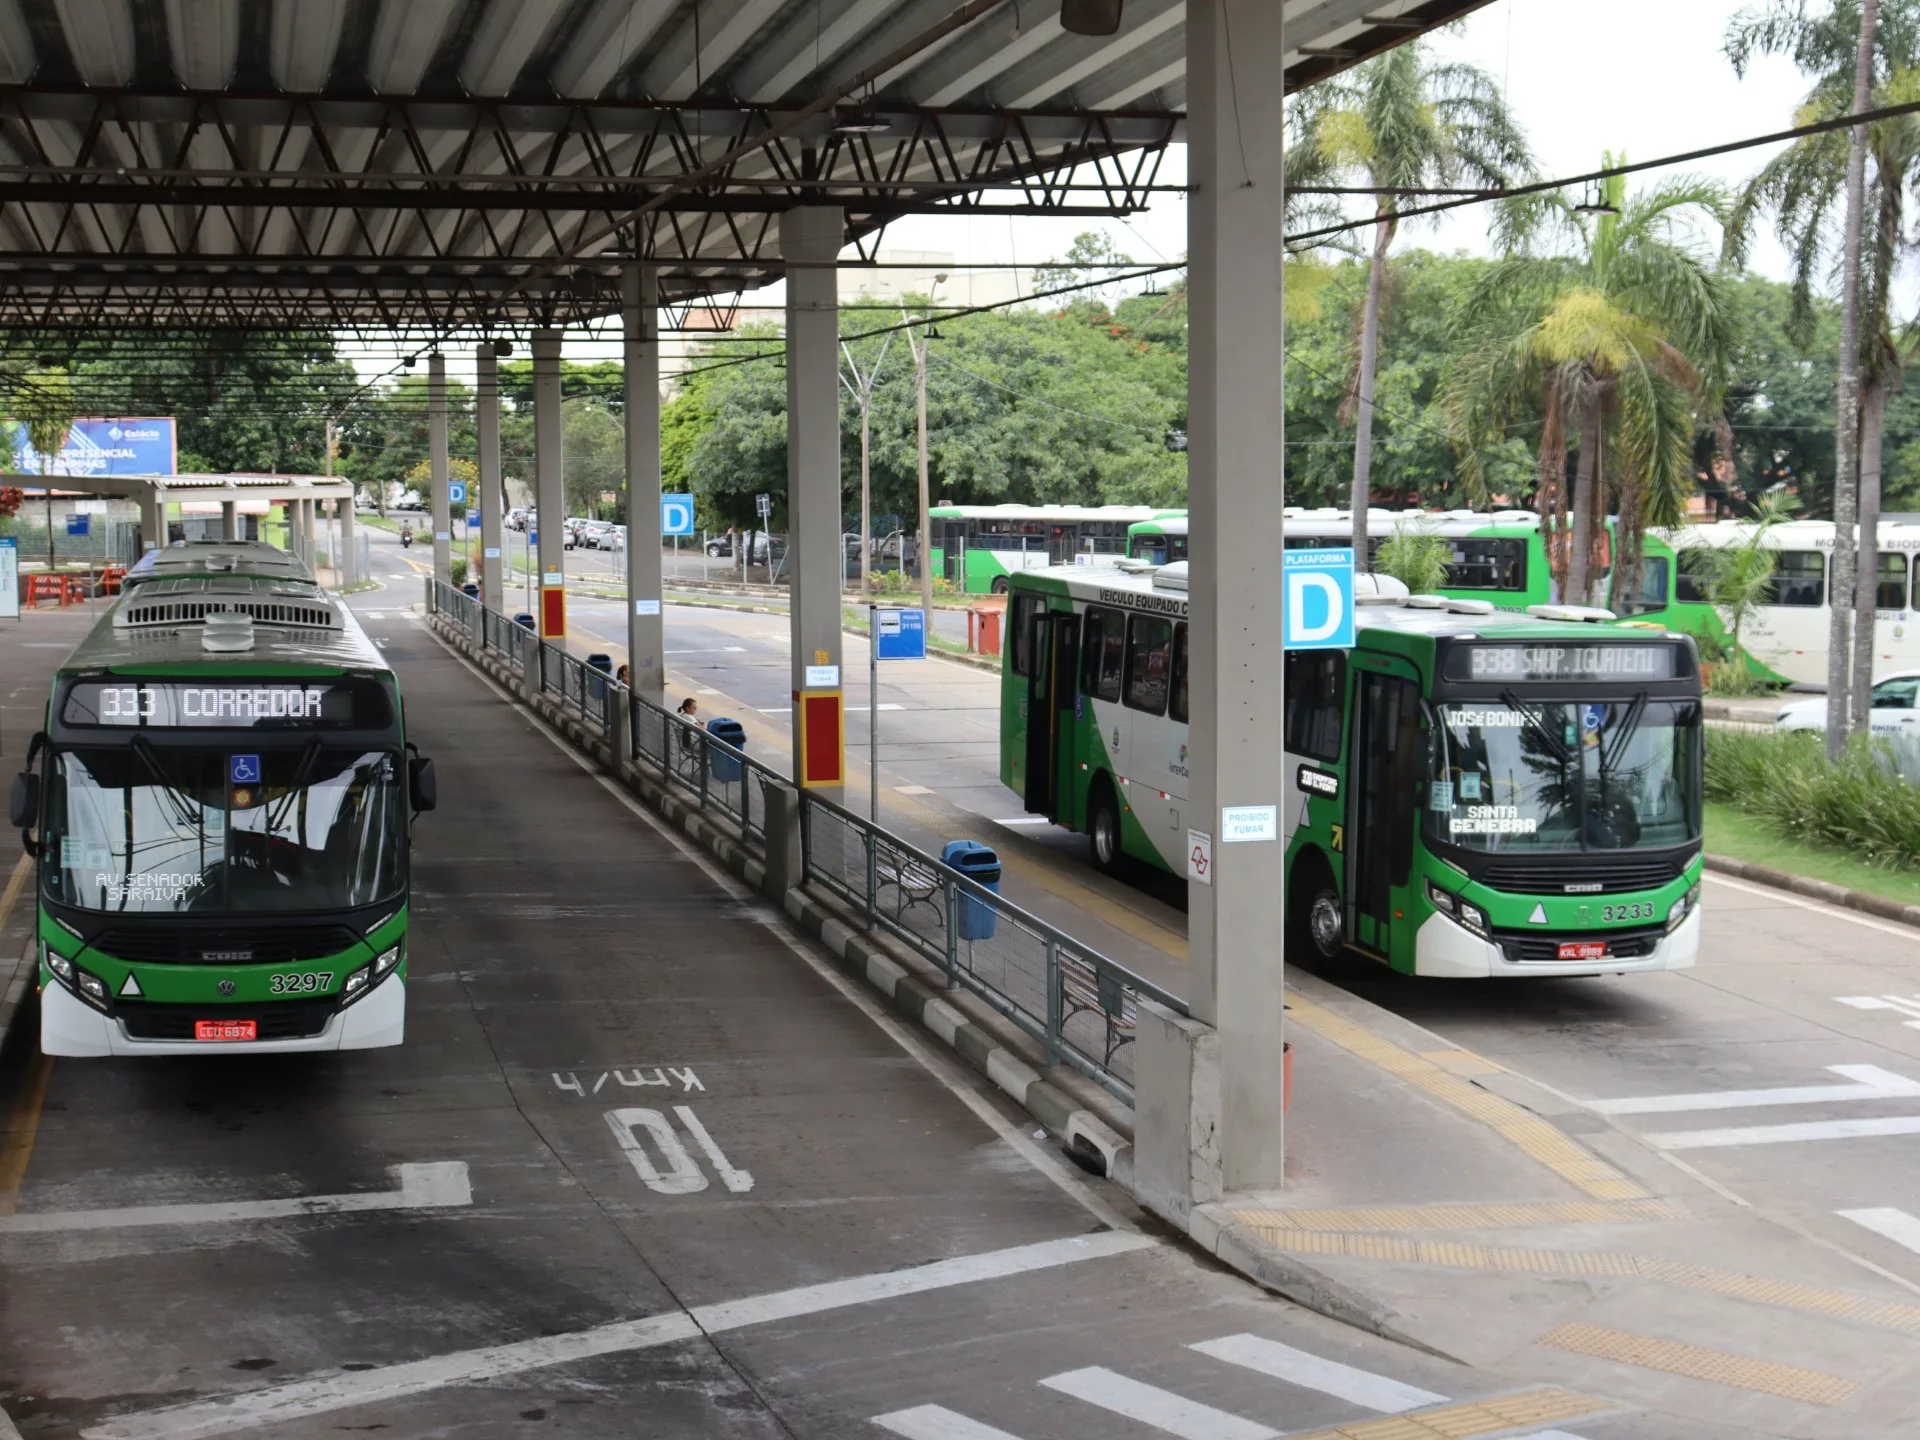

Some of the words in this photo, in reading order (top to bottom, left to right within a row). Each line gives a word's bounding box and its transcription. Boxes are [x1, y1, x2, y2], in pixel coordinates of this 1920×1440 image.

[450, 486, 463, 501] D
[663, 503, 689, 532] D
[1286, 554, 1346, 565] PLATAFORMA
[1099, 588, 1134, 606] VEICULO
[1135, 594, 1179, 614] EQUIPADO
[1289, 572, 1344, 642] D
[1471, 648, 1516, 674] 338
[103, 688, 156, 716] 333
[183, 688, 322, 717] CORREDOR
[1229, 812, 1269, 822] PROIBIDO
[1467, 805, 1518, 819] SANTA
[1234, 824, 1264, 834] FUMAR
[1450, 819, 1537, 833] GENEBRA
[107, 887, 186, 901] SARAIVA
[1602, 901, 1655, 922] 3233
[270, 971, 335, 994] 3297
[224, 1026, 253, 1037] 6874
[603, 1105, 755, 1194] 10
